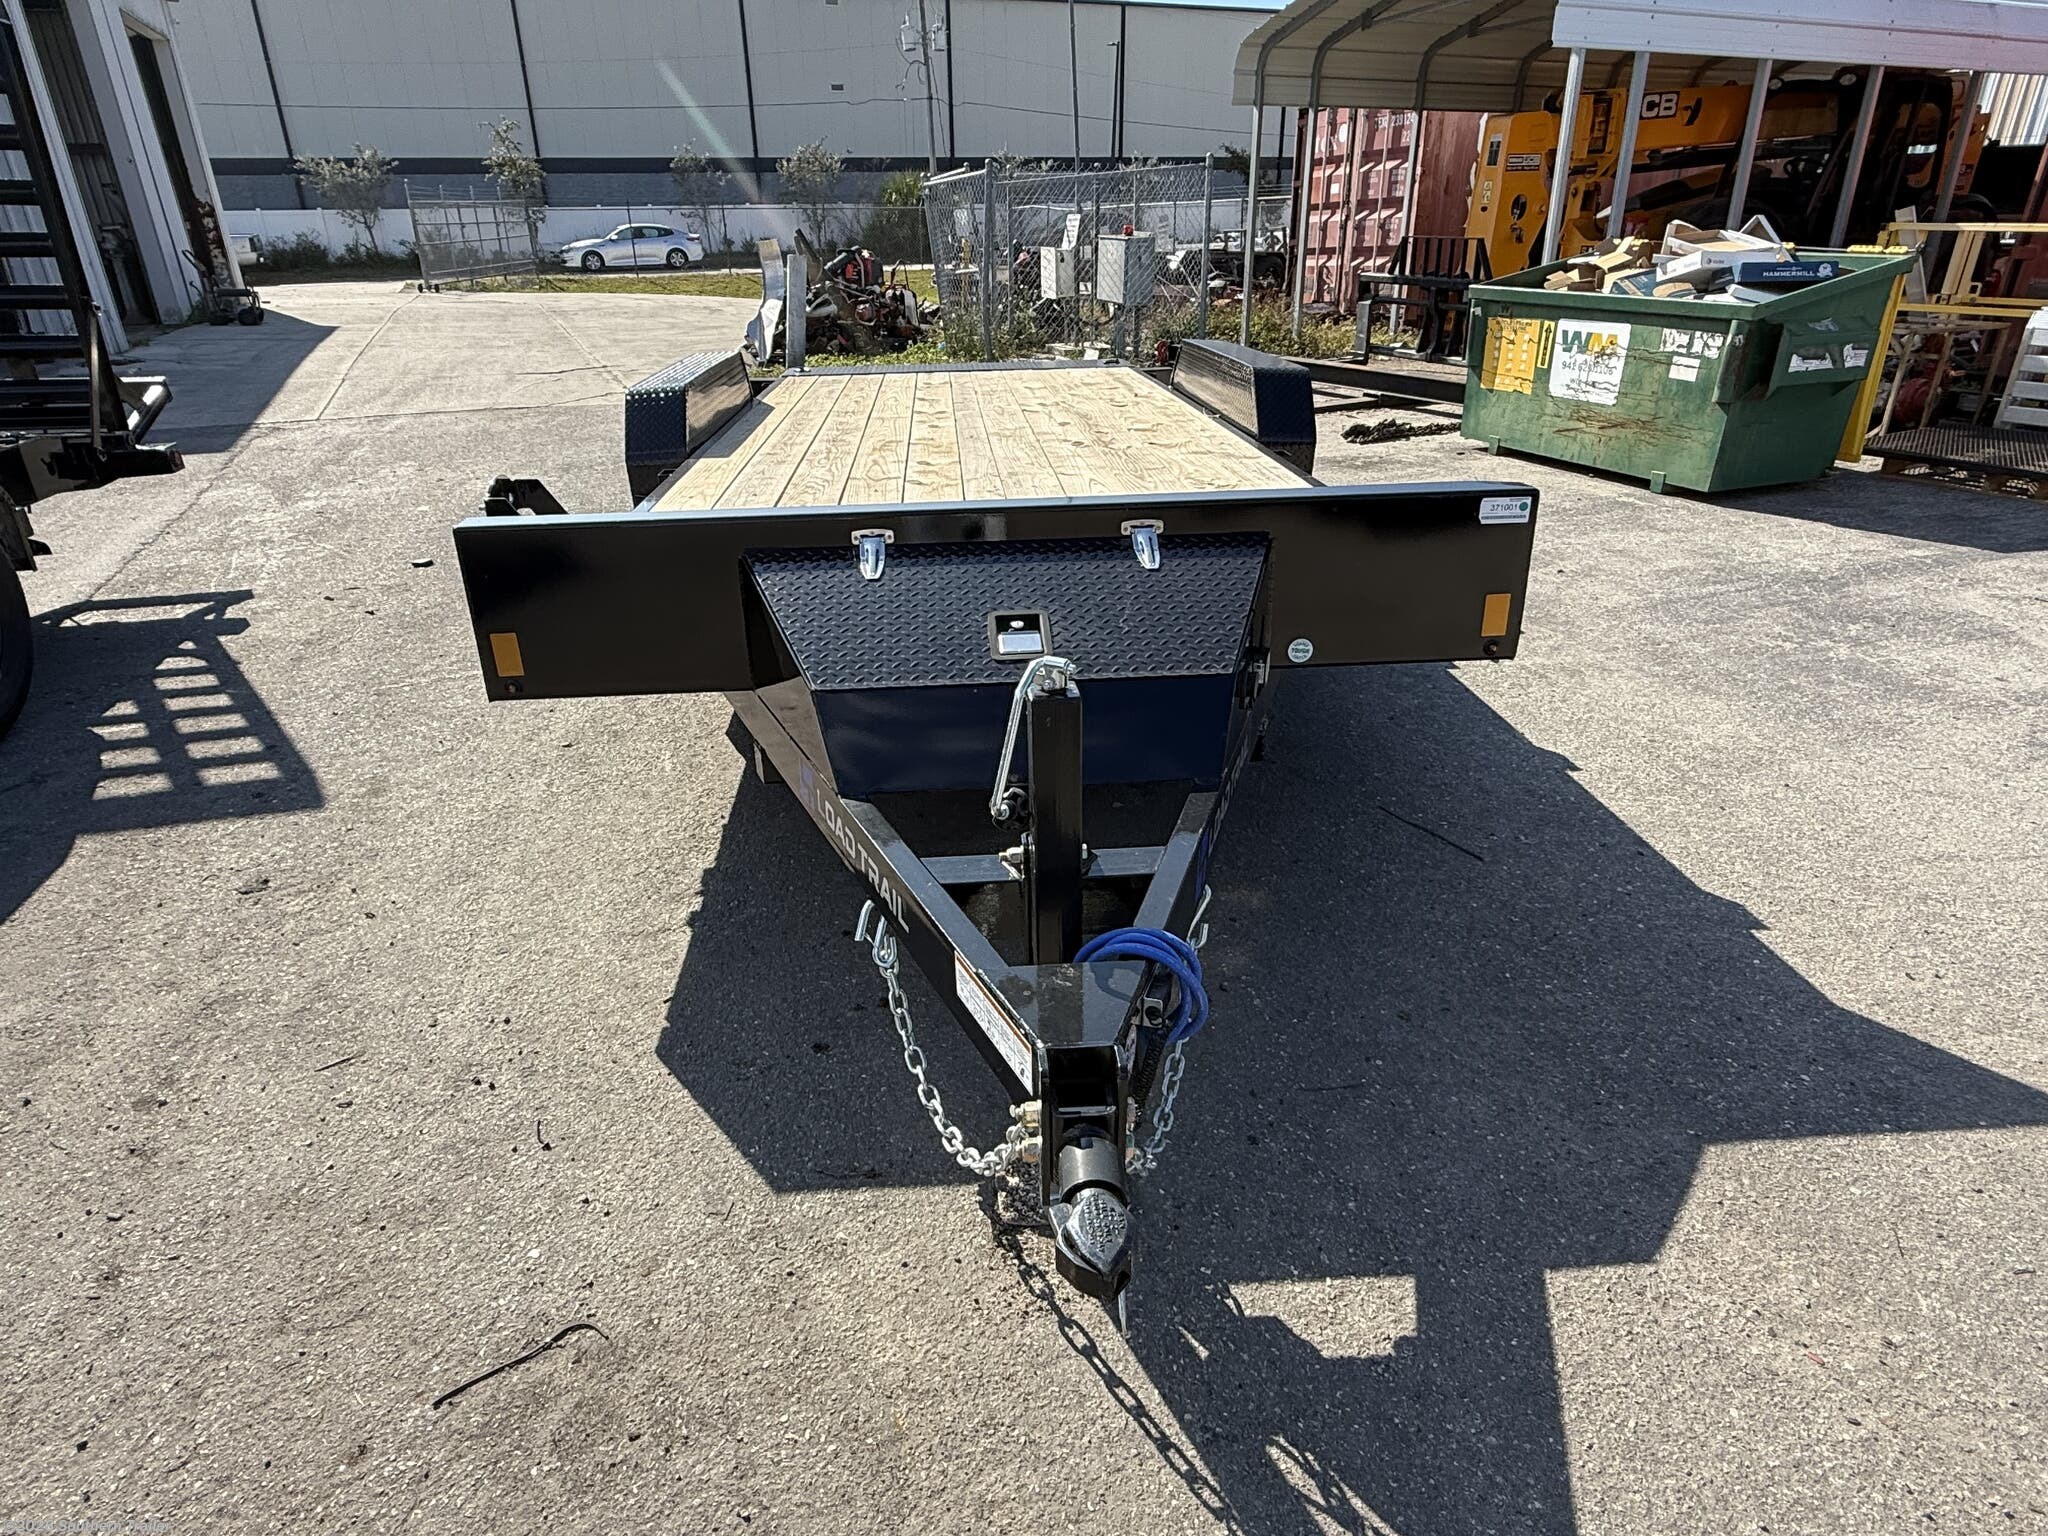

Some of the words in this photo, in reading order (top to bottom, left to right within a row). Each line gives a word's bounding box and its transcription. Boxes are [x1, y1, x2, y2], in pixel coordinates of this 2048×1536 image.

[1642, 92, 1677, 118] CB
[1562, 329, 1618, 356] WM
[1490, 504, 1518, 512] 371001
